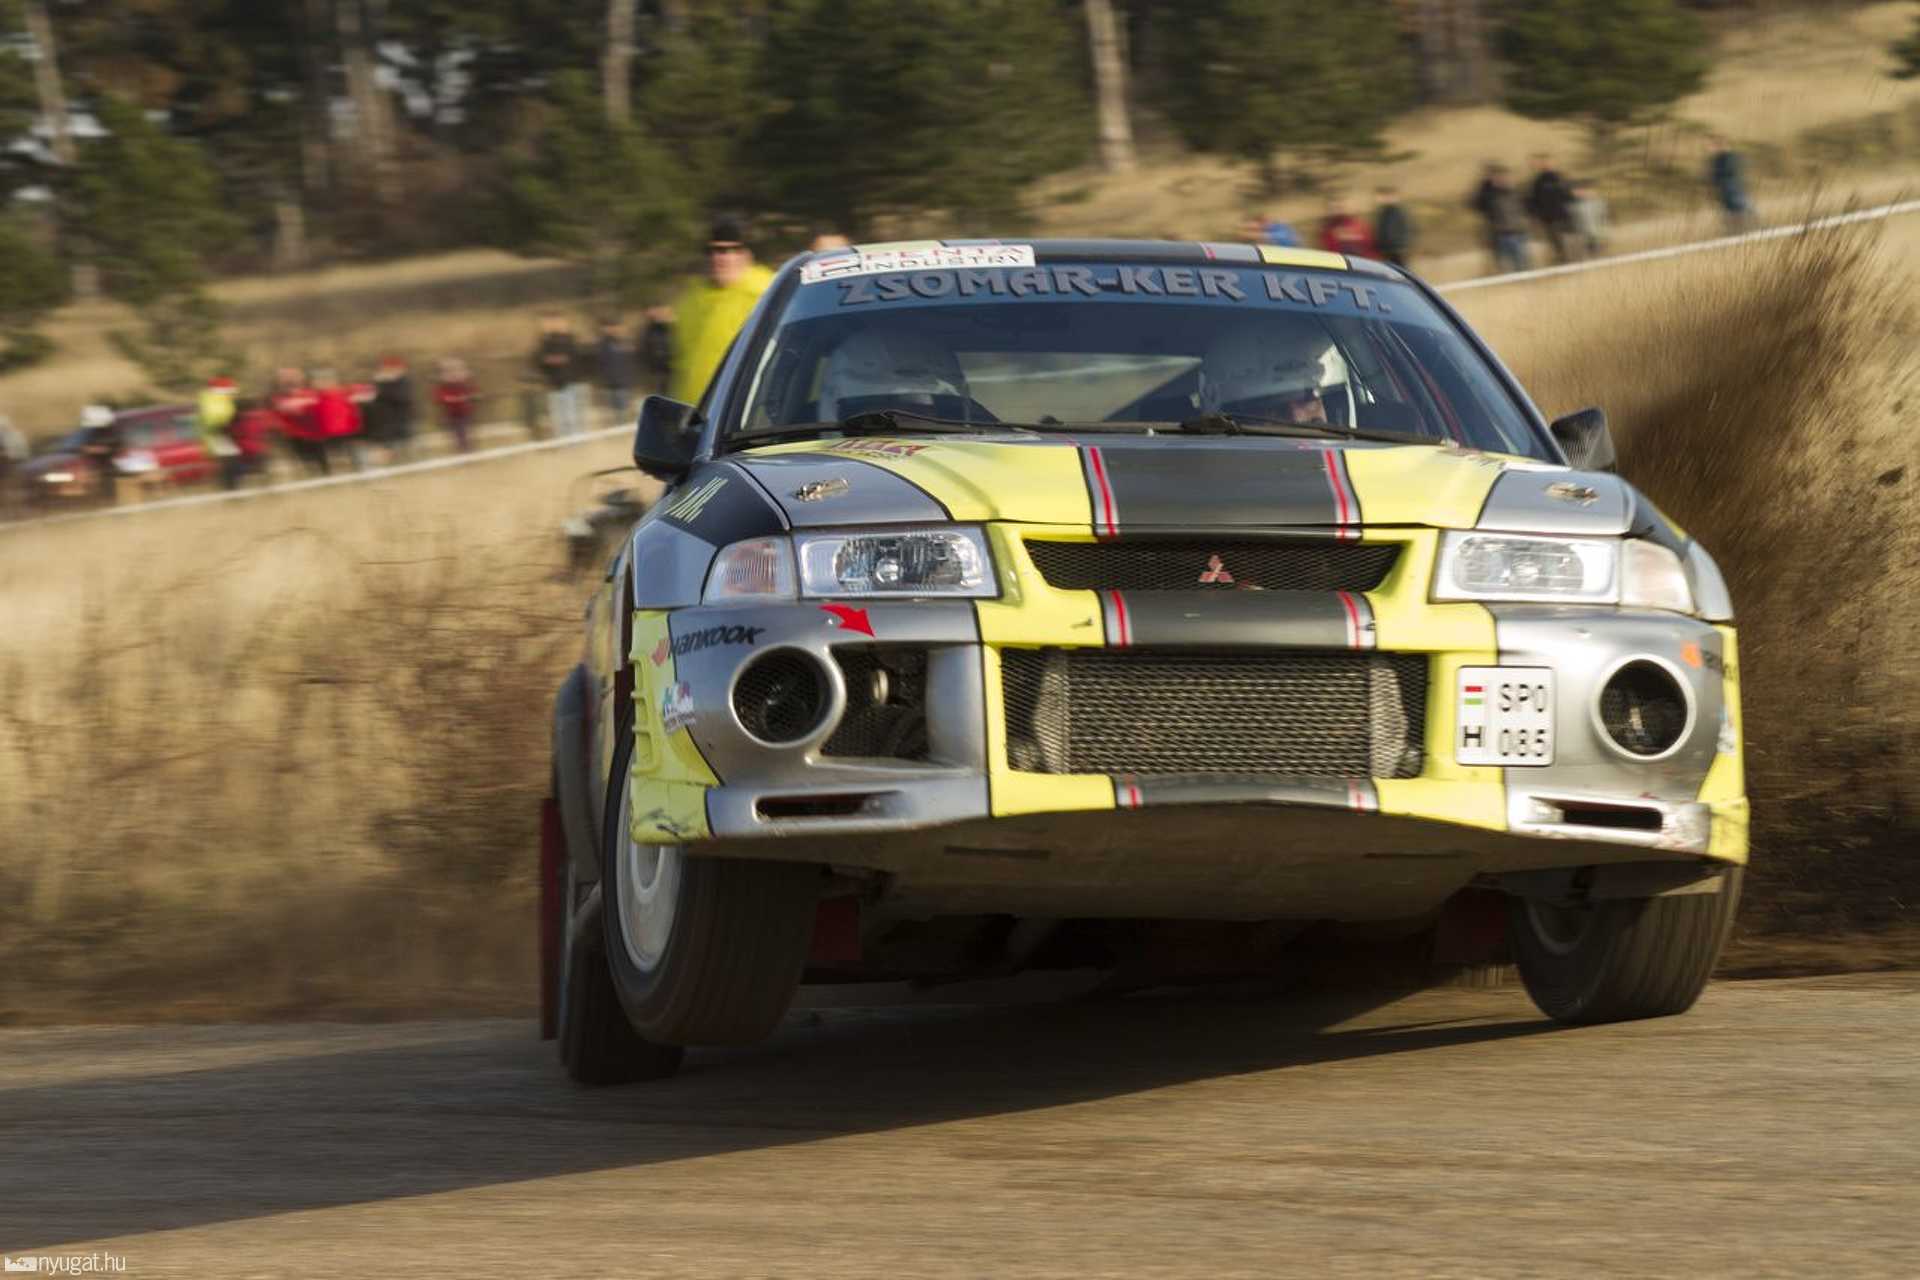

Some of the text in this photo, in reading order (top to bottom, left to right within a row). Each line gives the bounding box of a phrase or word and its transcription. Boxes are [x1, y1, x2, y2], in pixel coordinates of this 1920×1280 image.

[866, 254, 1020, 271] INDUSTRY
[838, 265, 1393, 314] ZSOMAR-KER KFT.
[1463, 725, 1484, 748] H
[1499, 728, 1548, 758] 085
